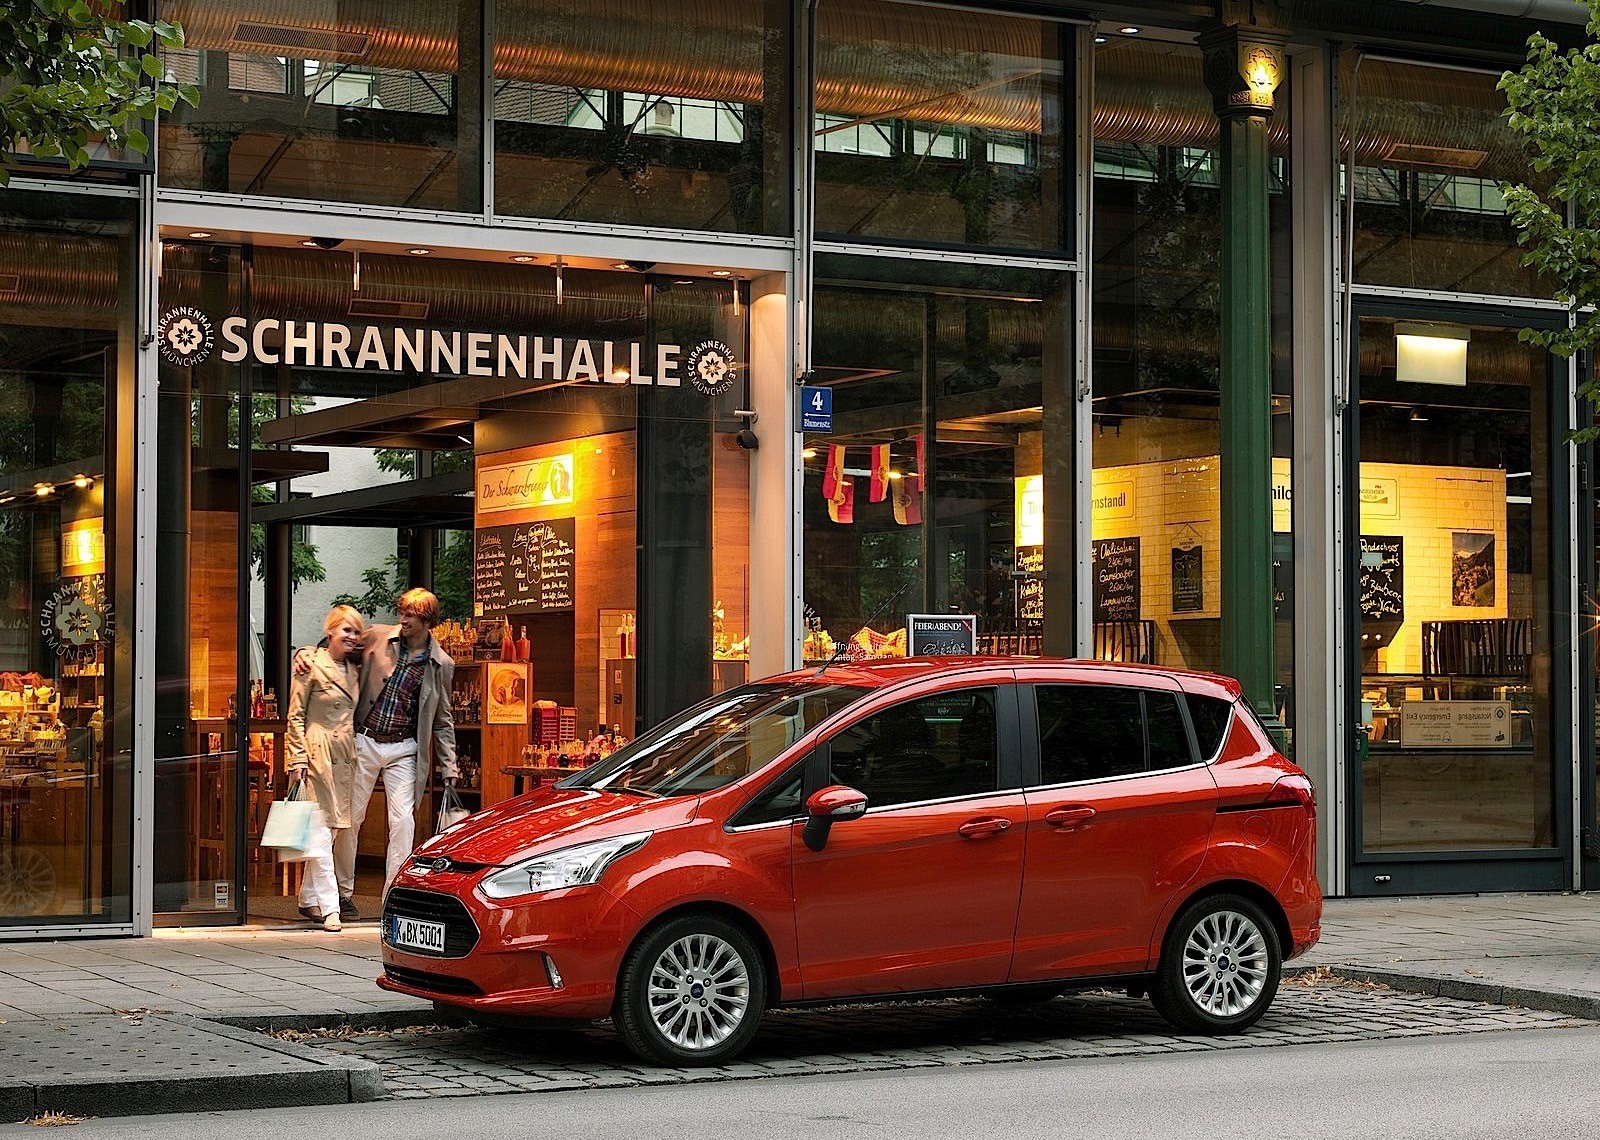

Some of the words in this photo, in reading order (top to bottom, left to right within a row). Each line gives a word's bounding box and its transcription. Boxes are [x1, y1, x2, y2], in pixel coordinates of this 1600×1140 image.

[157, 306, 215, 349] SCHRANNENHALLE
[221, 316, 682, 387] SCHRANNENHALLE
[687, 340, 737, 380] SCHRANNENHALLE
[811, 391, 824, 411] 4
[40, 583, 116, 637] SCHRANNALLE
[419, 925, 442, 949] 5001
